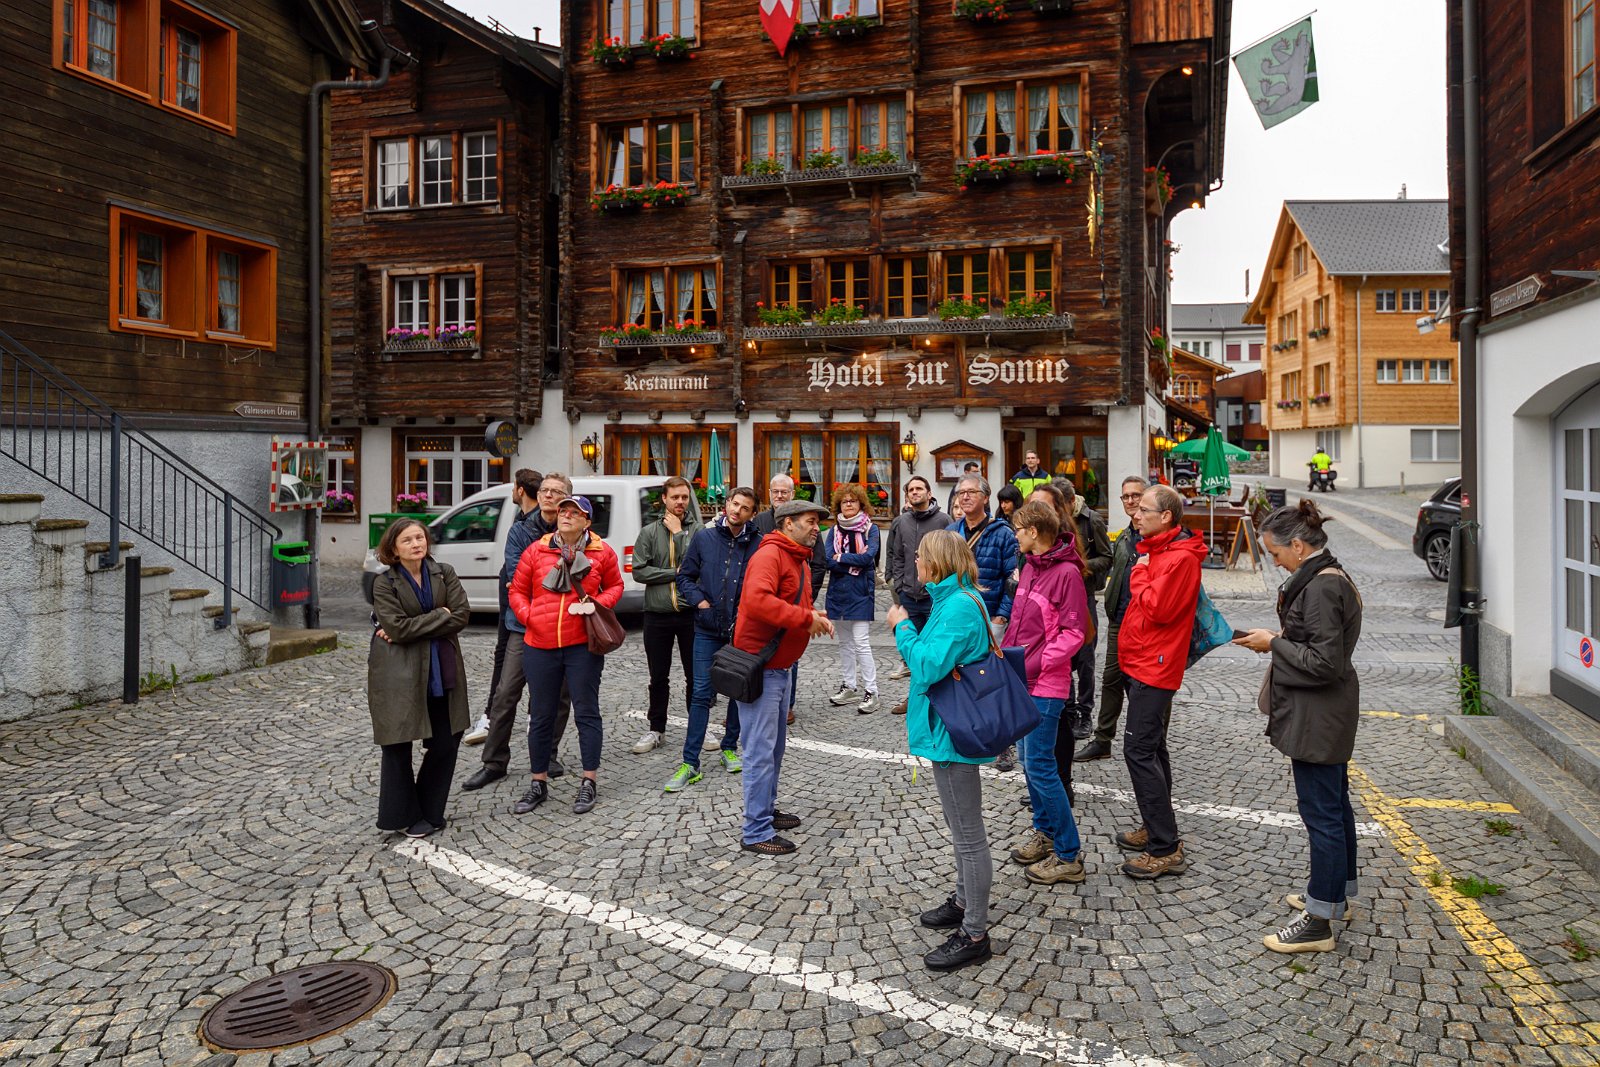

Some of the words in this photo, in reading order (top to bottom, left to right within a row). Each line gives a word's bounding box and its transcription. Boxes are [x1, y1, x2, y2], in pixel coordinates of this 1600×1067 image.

[623, 373, 709, 391] Restaurant
[806, 356, 885, 393] Hotel
[904, 360, 949, 391] zur
[968, 352, 1070, 386] Sonne
